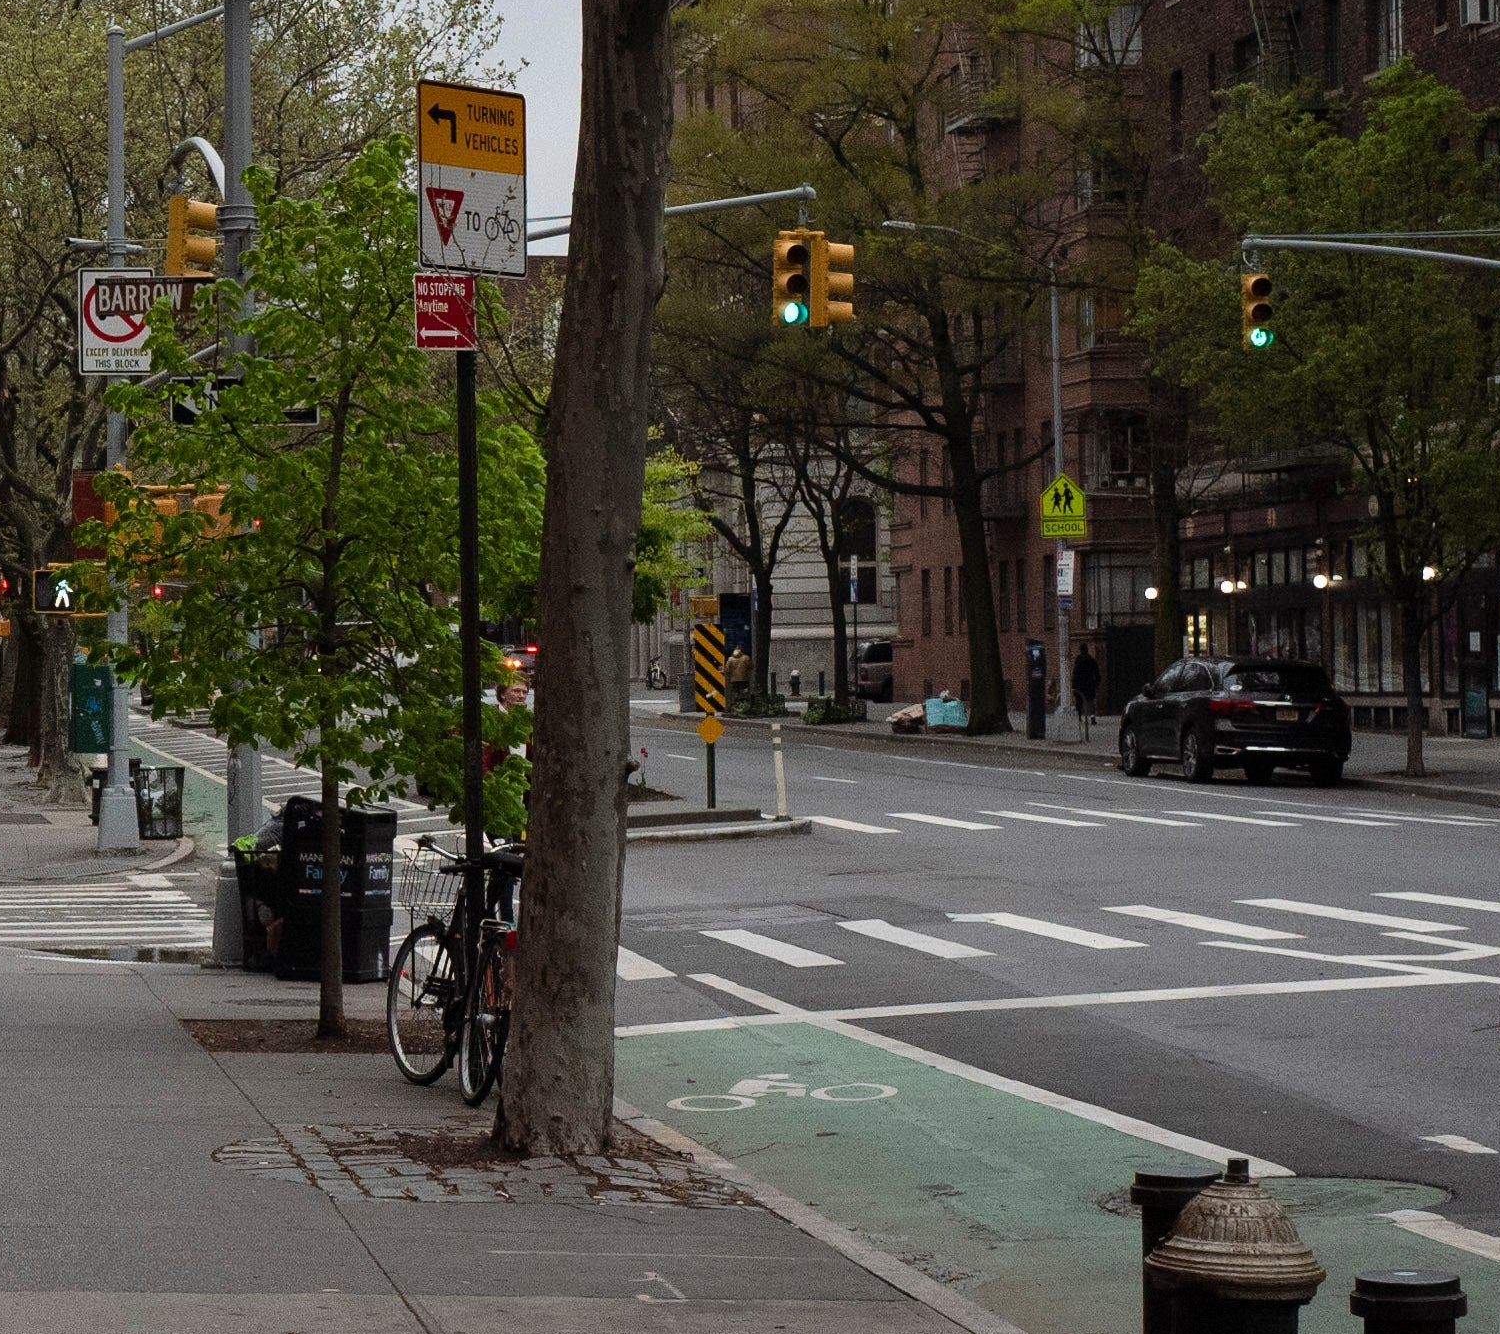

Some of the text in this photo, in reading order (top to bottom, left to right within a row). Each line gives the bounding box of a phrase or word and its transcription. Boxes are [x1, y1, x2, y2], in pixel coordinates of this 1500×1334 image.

[466, 104, 515, 127] TURNING
[464, 132, 518, 156] VEHICLES
[465, 211, 481, 232] TO
[417, 282, 428, 295] NO
[99, 283, 183, 312] BARROW
[85, 348, 108, 357] EXCEPT
[95, 359, 140, 368] THIS BLOCK
[1045, 523, 1083, 533] SCHOOL
